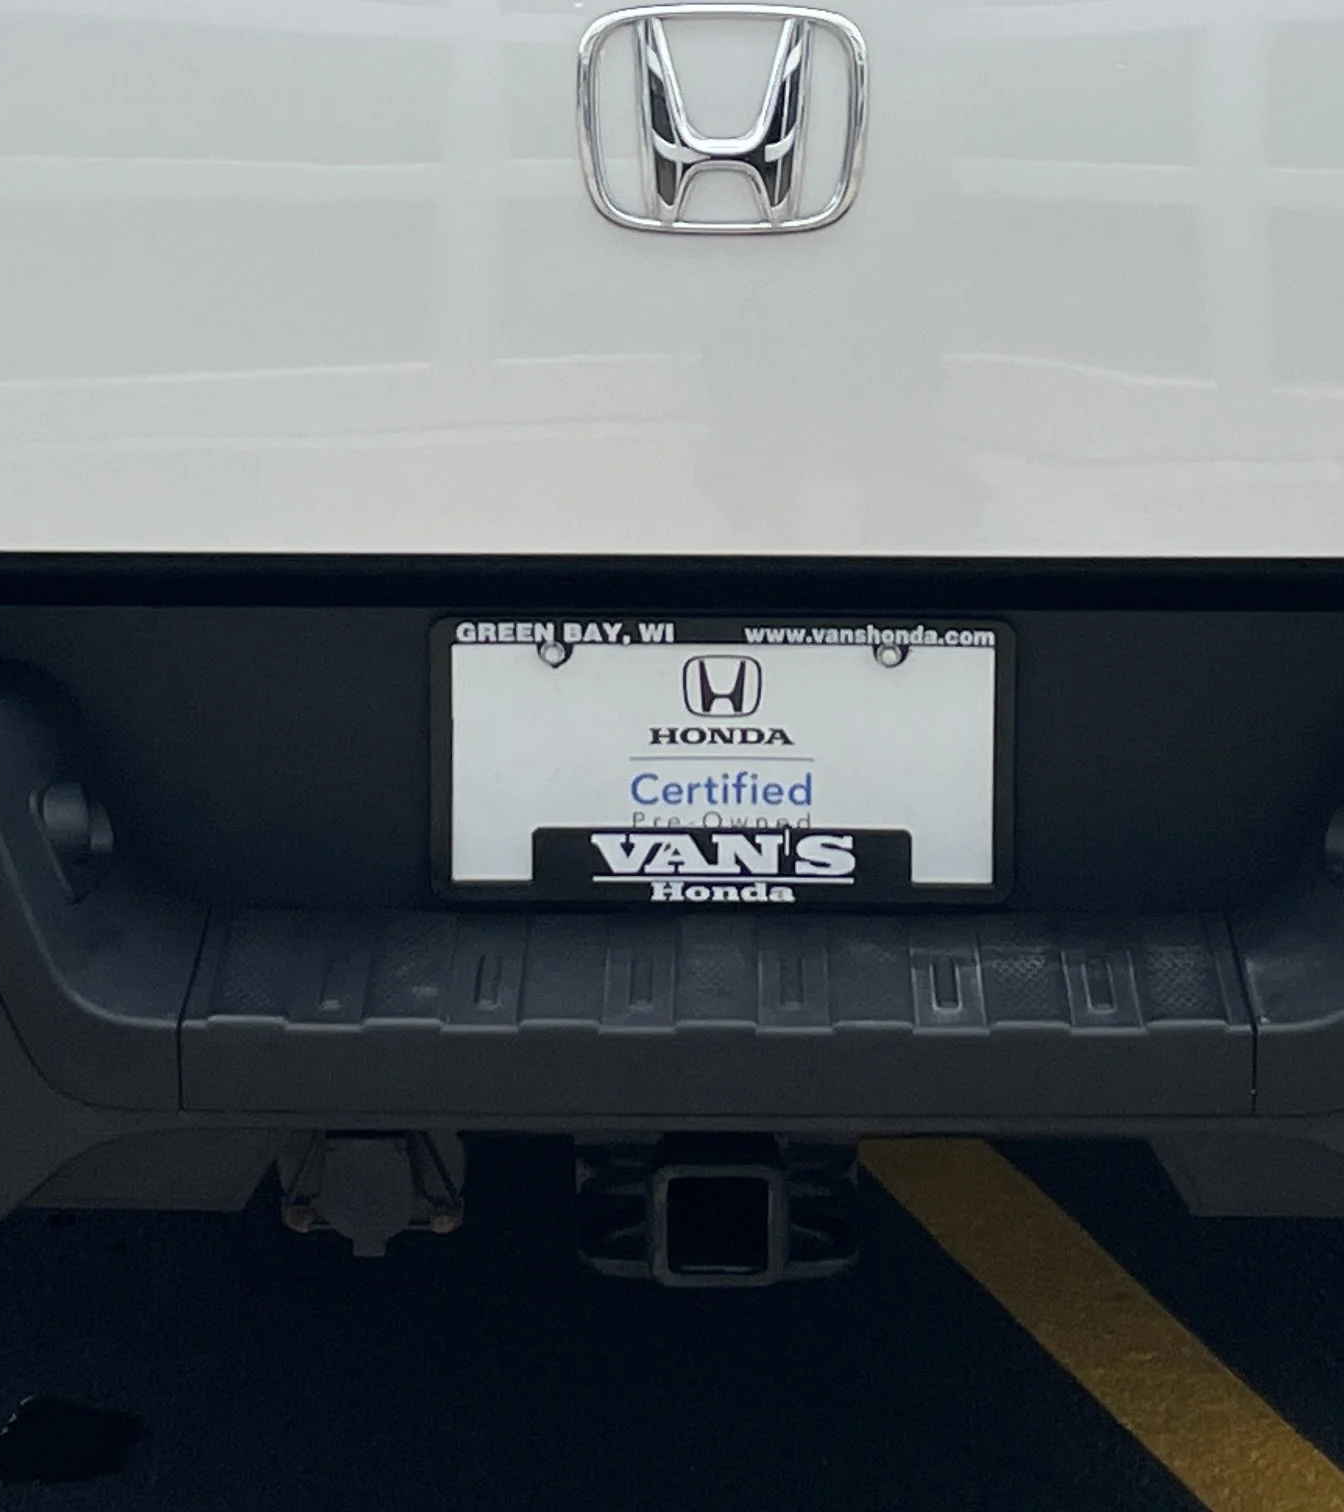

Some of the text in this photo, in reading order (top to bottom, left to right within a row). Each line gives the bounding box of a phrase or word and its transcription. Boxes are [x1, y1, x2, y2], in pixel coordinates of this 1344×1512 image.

[455, 621, 676, 646] GREEN BAY, WI
[744, 624, 996, 646] www.vanshonda.com
[649, 727, 796, 746] HONDA
[630, 771, 813, 807] Certified
[631, 810, 813, 829] Pre-Owned
[590, 828, 856, 876] VAN'S
[650, 881, 796, 903] Honda
